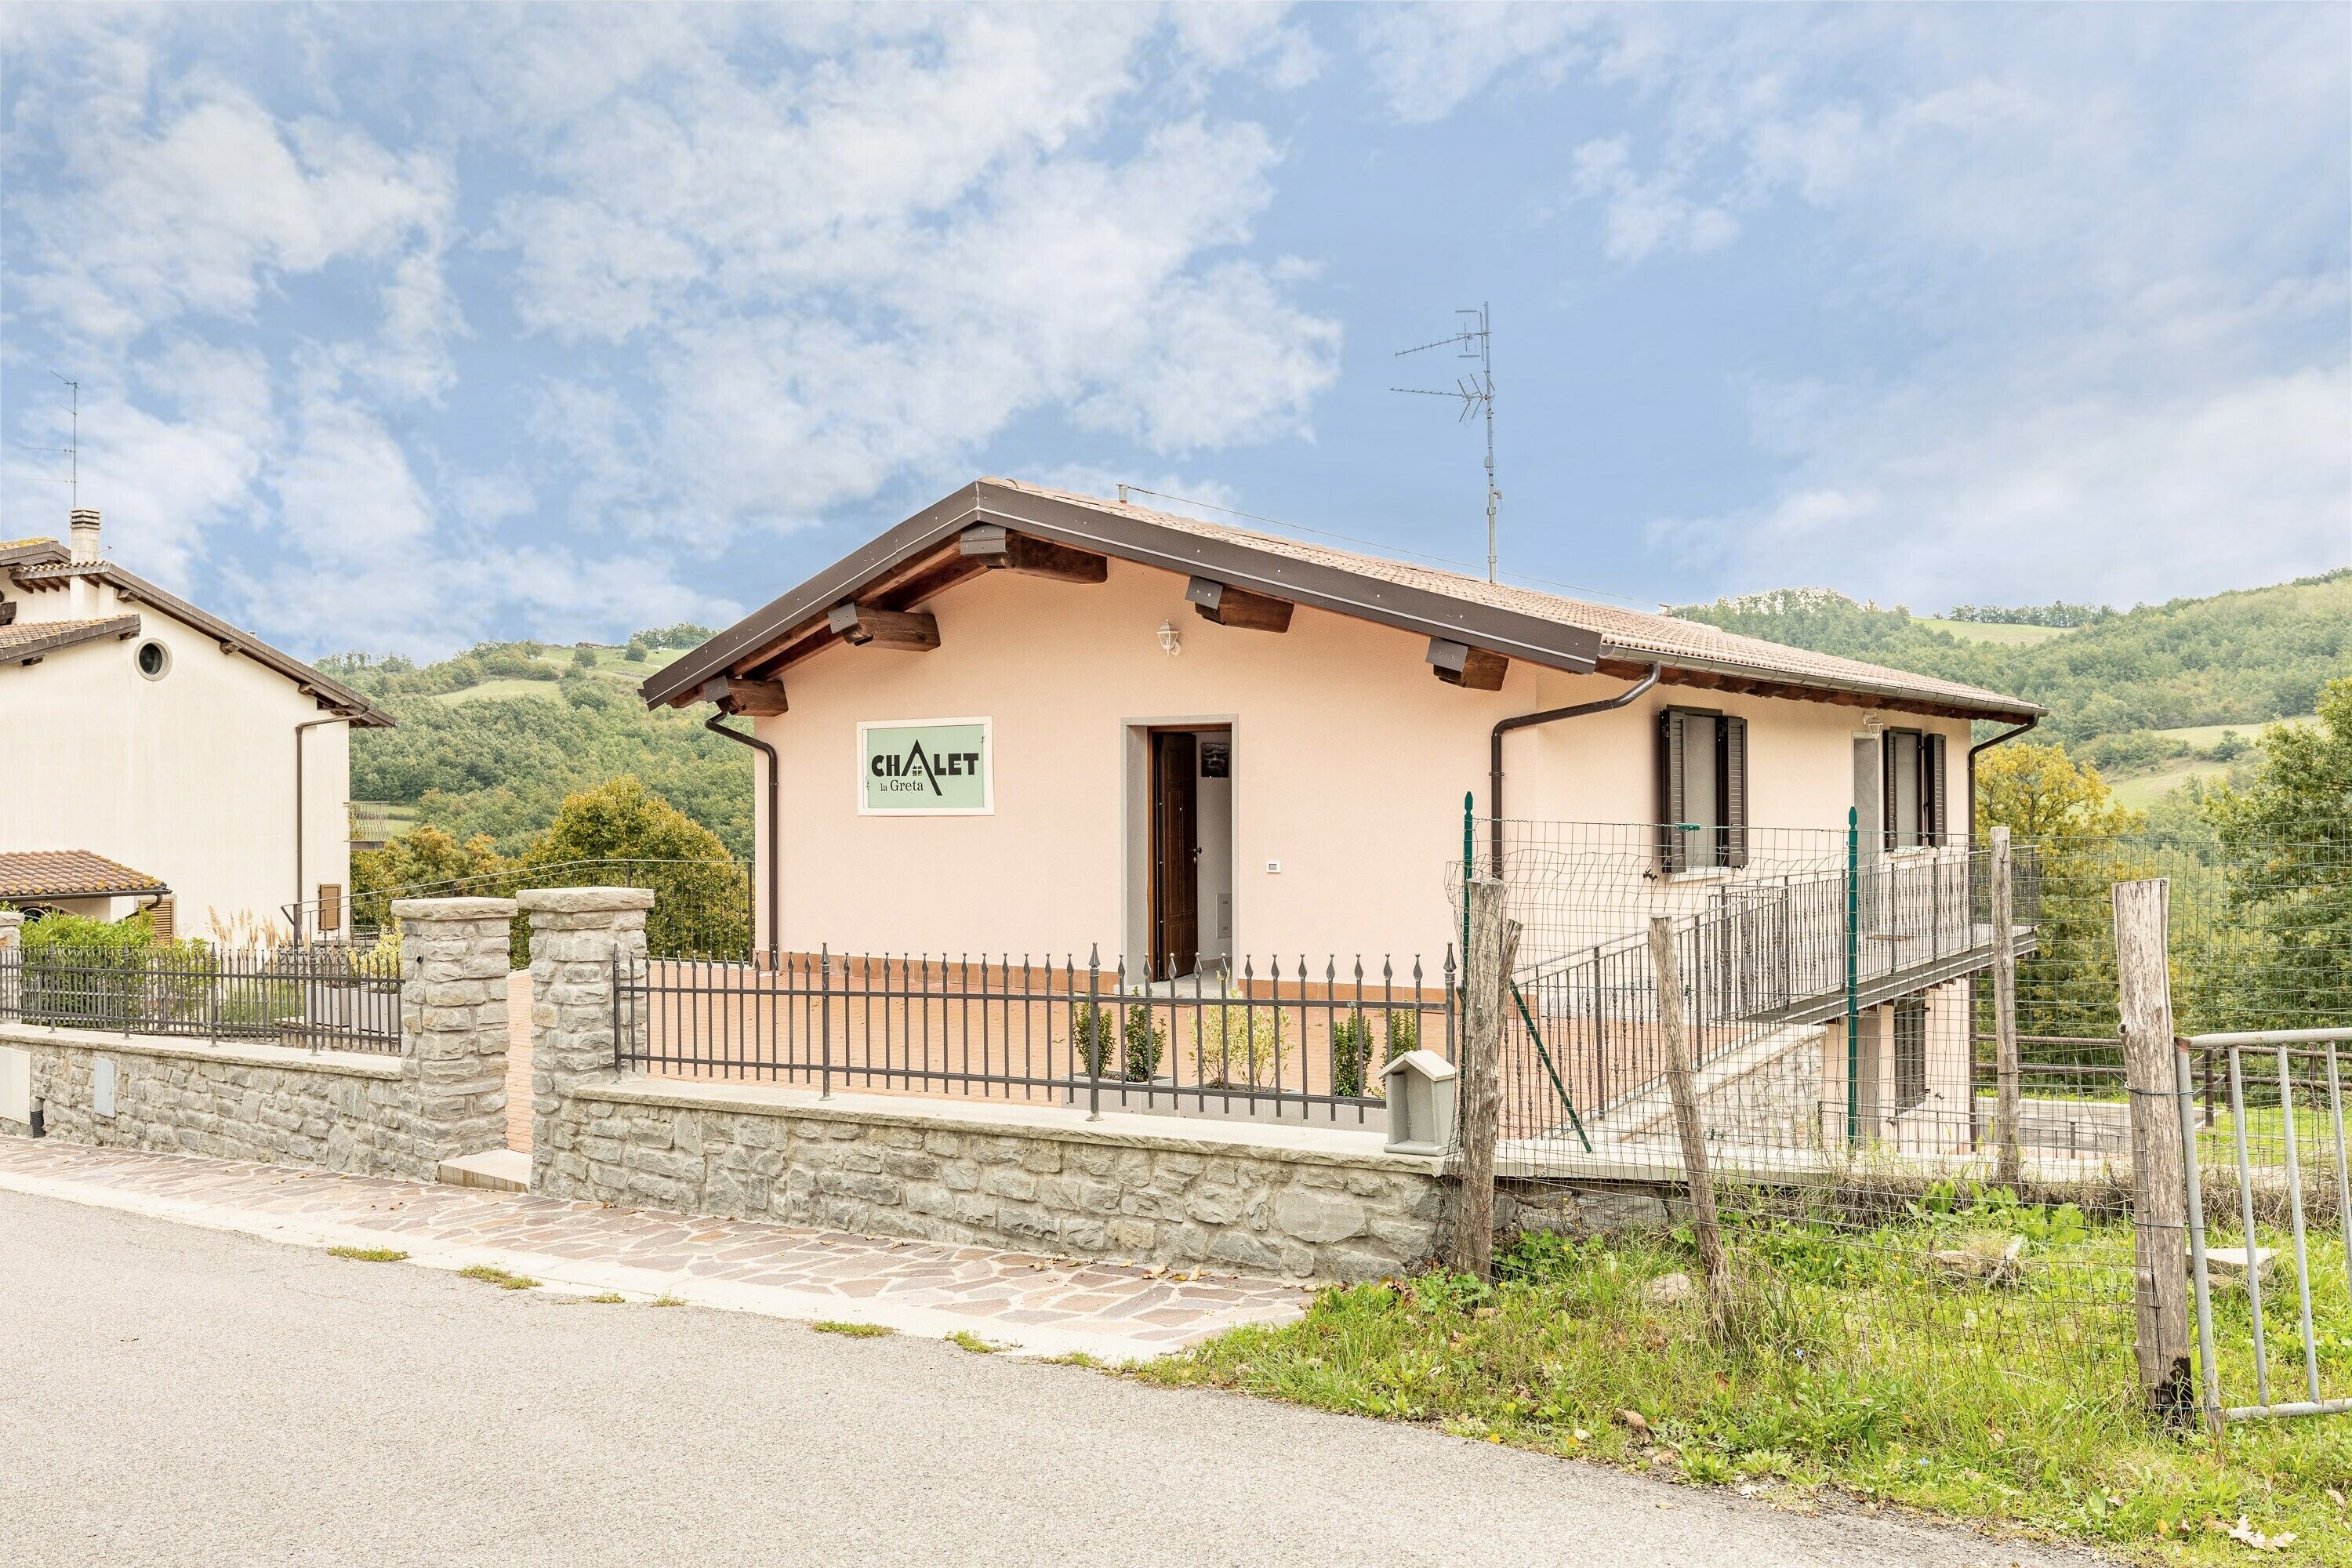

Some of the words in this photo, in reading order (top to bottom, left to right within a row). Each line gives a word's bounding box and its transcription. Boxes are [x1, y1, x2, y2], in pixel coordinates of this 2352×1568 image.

[871, 739, 979, 797] CHALET
[880, 783, 887, 792] la
[890, 779, 924, 792] Greta
